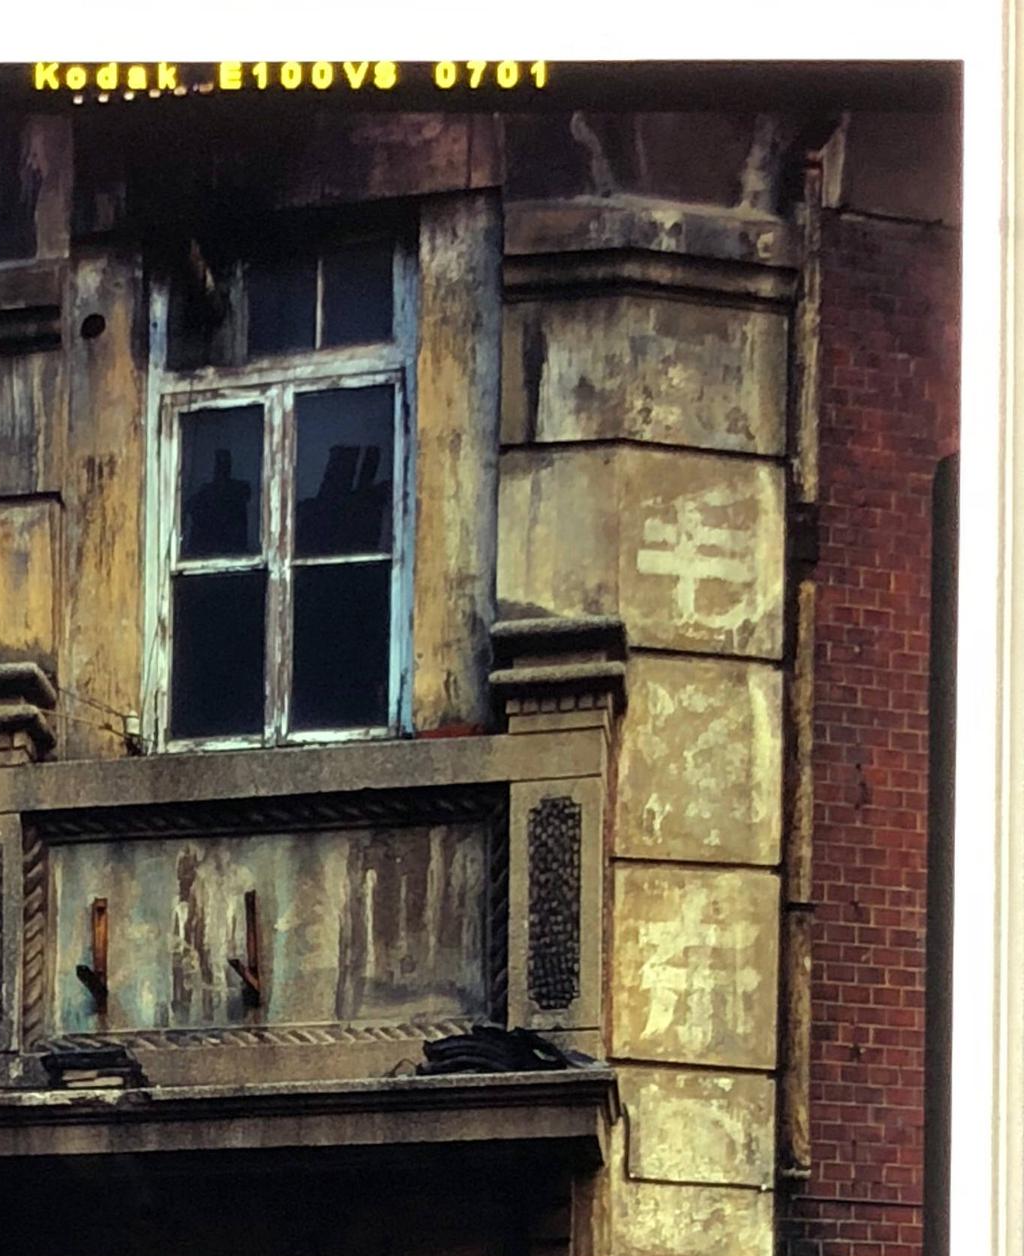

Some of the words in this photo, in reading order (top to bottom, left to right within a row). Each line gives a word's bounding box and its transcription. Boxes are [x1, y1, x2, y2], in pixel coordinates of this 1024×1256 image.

[34, 62, 179, 91] Kodak
[219, 61, 398, 91] E100VS
[434, 61, 549, 90] 0701
